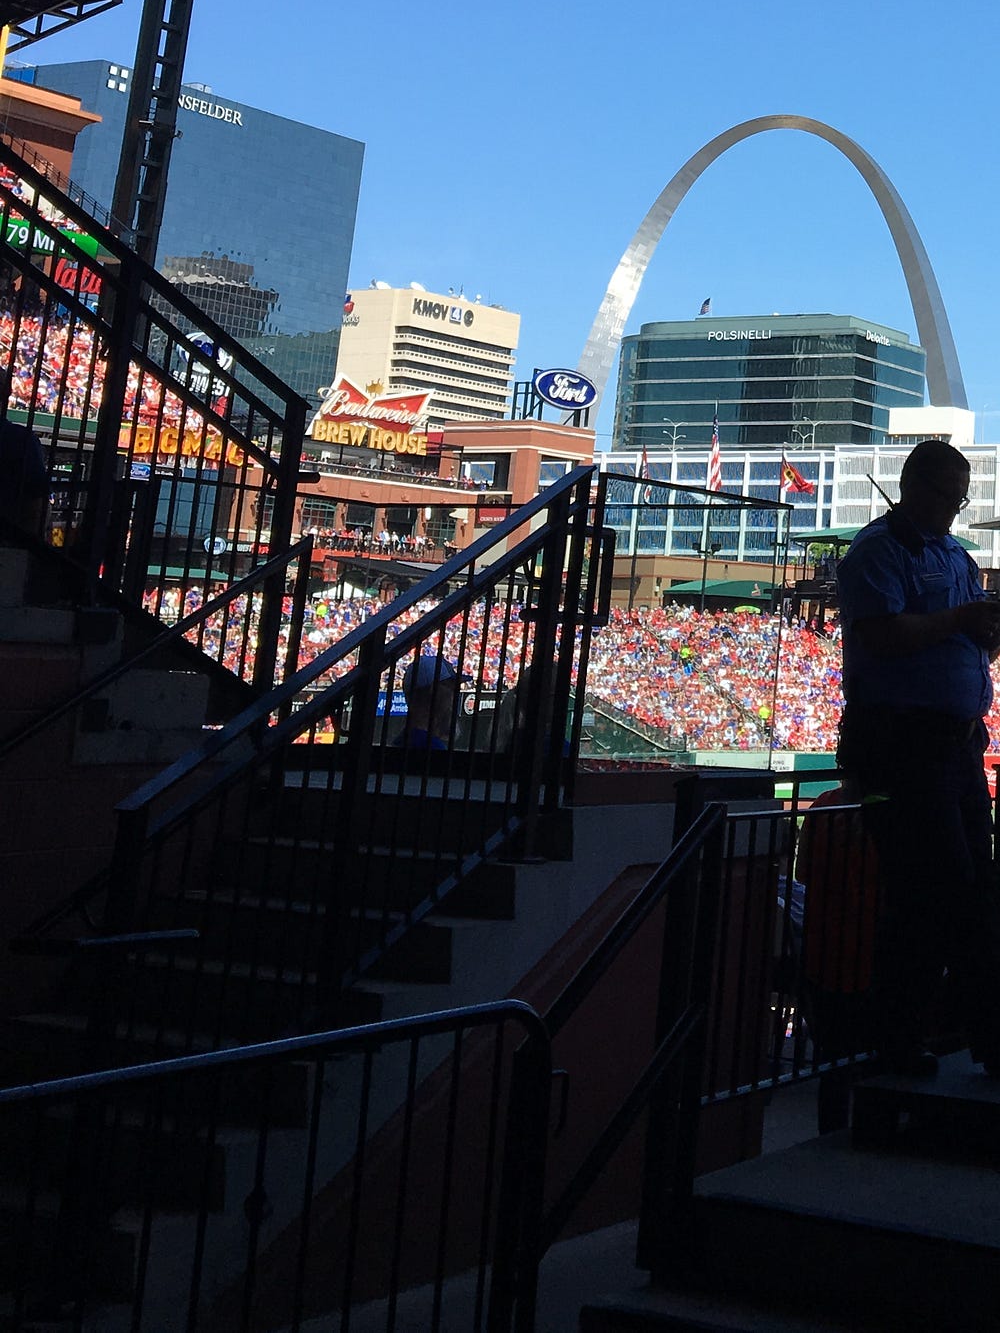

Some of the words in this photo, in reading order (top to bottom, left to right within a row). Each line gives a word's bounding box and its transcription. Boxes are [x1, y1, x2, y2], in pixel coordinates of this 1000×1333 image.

[7, 224, 29, 244] 79
[412, 297, 449, 321] KMOV
[708, 329, 772, 341] POLSINELLI
[548, 371, 588, 403] Ford
[317, 387, 429, 425] Budweiser
[312, 419, 368, 447] BREW
[368, 427, 429, 457] HOUSE
